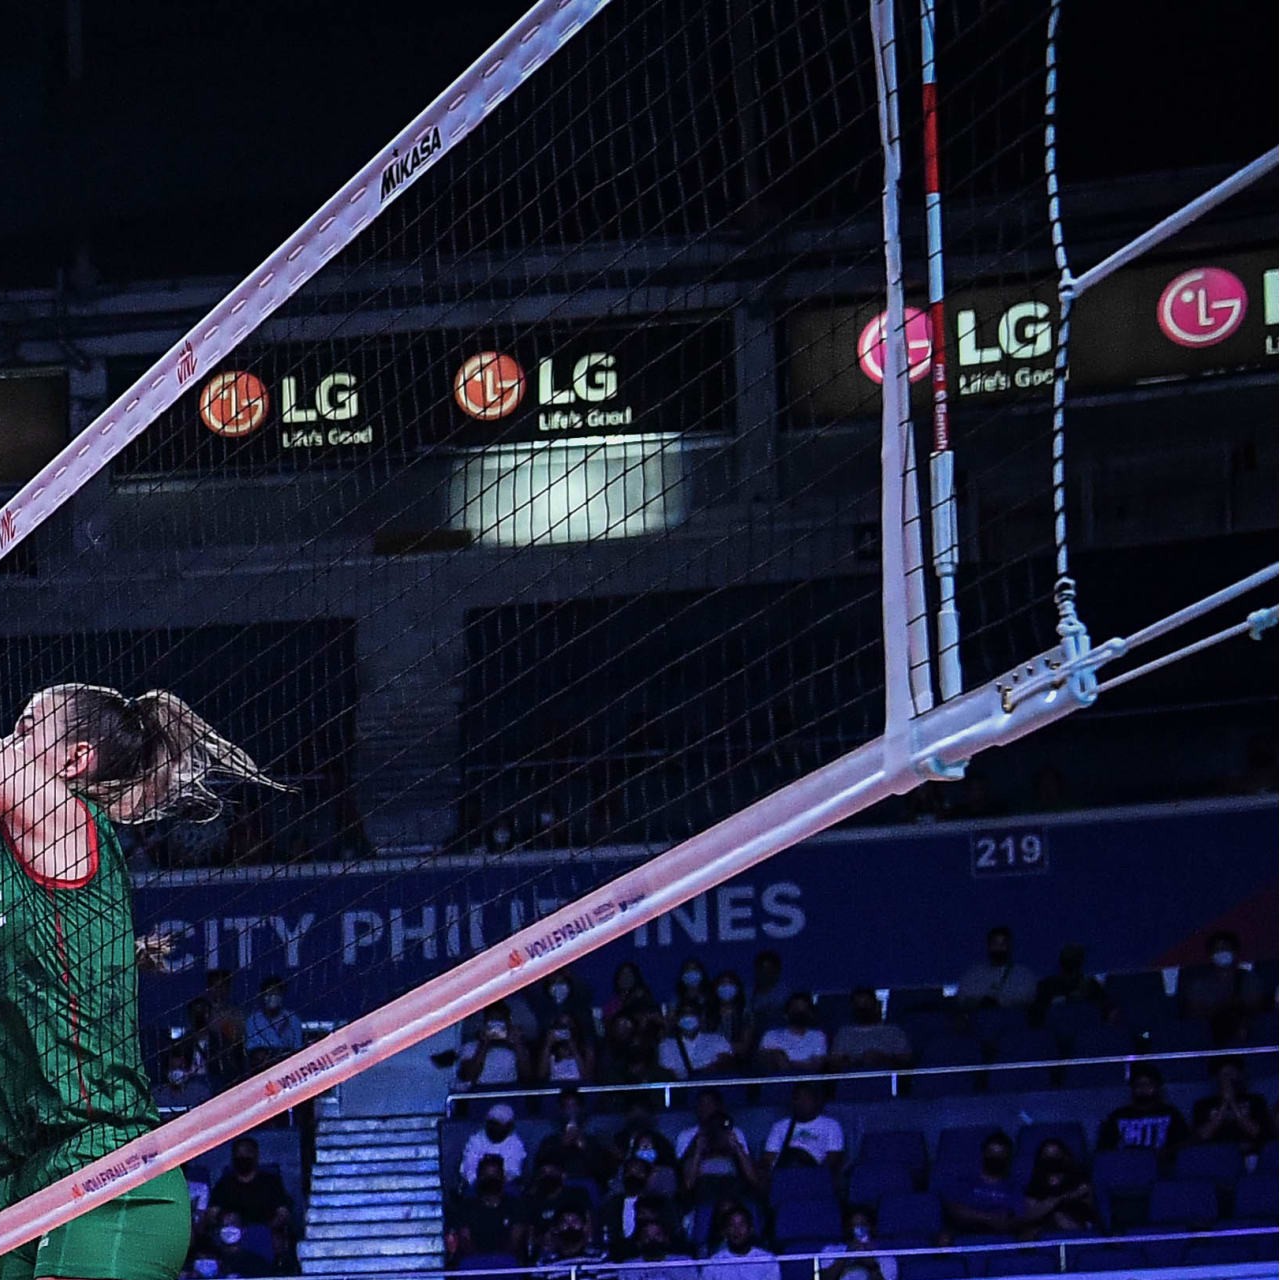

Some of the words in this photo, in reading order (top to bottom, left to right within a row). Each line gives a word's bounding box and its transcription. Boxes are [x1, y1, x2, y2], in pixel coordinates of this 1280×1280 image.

[380, 126, 442, 203] MIKASA
[957, 301, 1052, 366] LG
[282, 372, 359, 423] LG
[538, 352, 619, 405] LG
[975, 833, 1042, 869] 219
[154, 916, 315, 973] CITY
